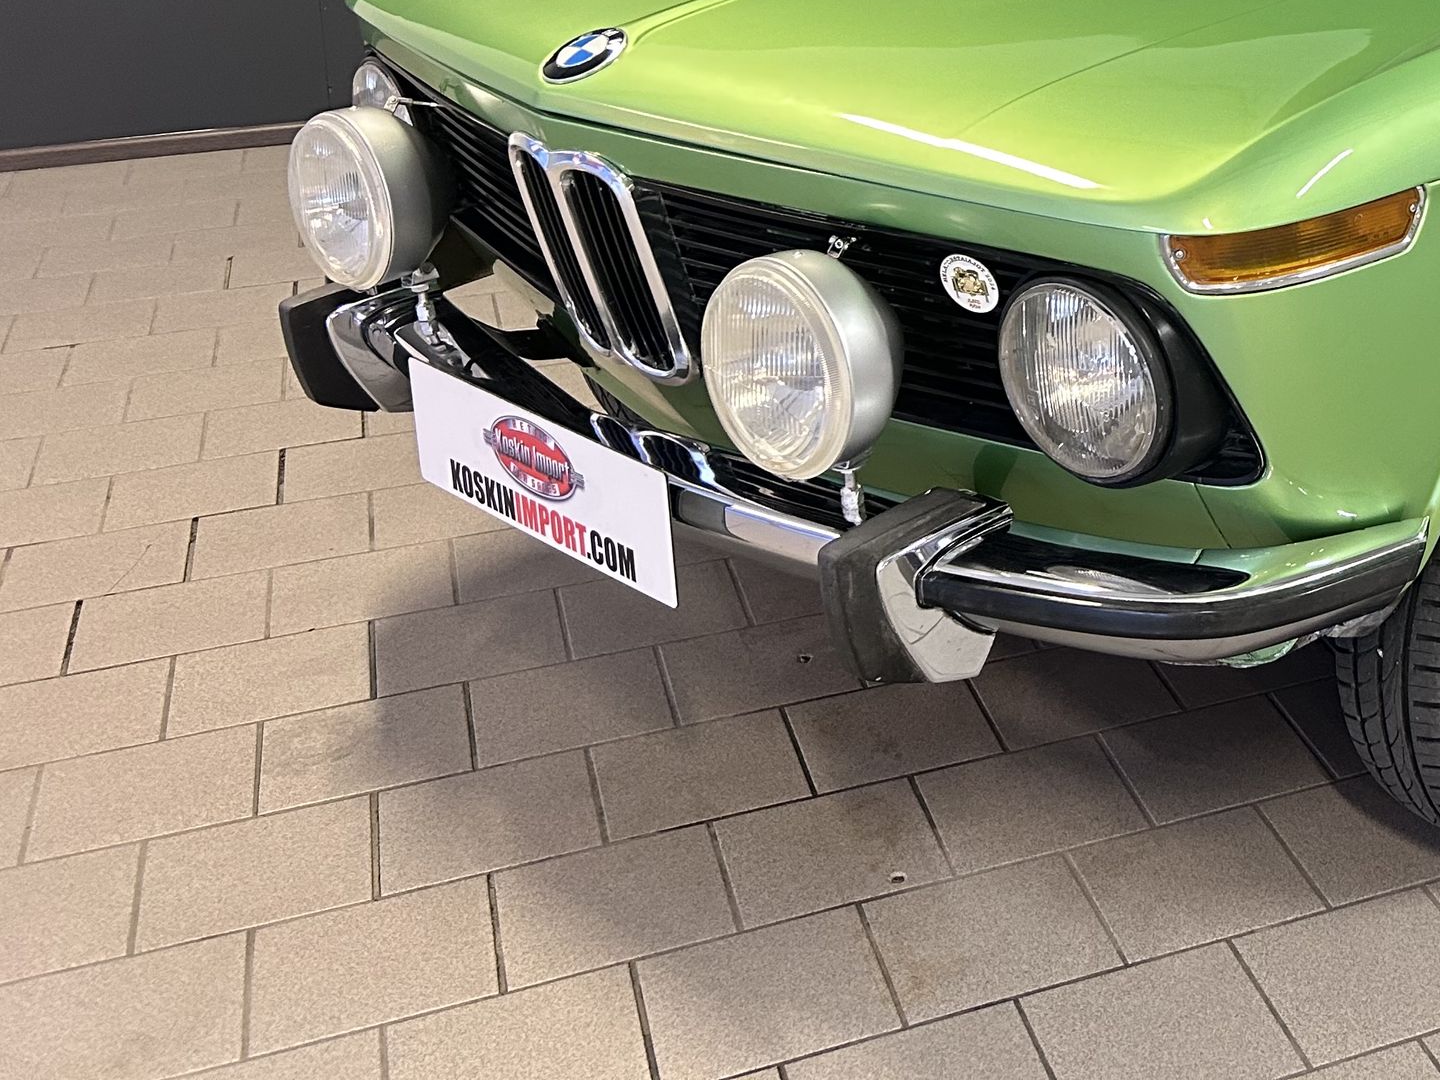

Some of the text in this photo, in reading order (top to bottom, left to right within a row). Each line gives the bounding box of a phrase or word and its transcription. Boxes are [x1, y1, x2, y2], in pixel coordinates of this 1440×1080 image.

[495, 428, 570, 485] Koskin Import
[450, 458, 637, 583] KOSKINIMPORT.COM
